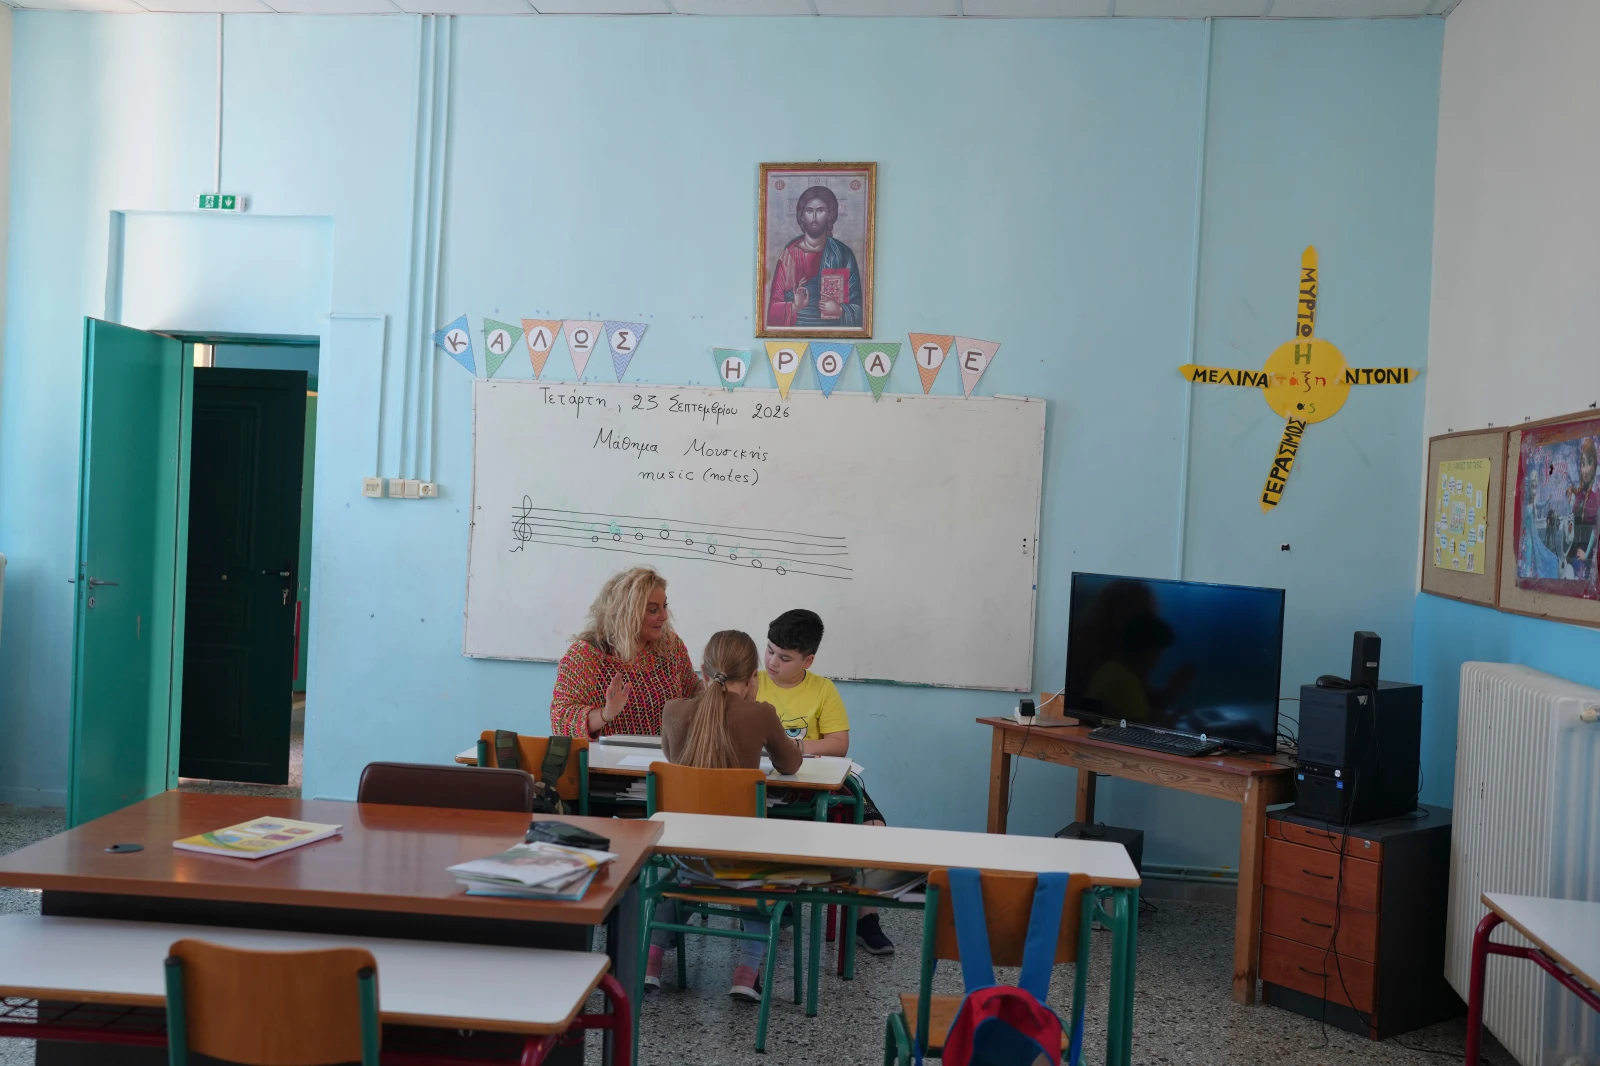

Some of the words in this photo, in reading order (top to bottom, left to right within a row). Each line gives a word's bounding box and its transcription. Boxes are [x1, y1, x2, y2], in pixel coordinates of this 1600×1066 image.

[1296, 268, 1317, 337] ΜΥΡΤΩ
[447, 330, 630, 352] ΚΑΛΩΣ
[725, 346, 983, 379] ΗΡΘΑΤΕ
[1294, 343, 1313, 365] Η
[1192, 368, 1269, 388] ΜΕΛΙΝΑ
[1275, 371, 1327, 393] τάξη
[1345, 368, 1409, 385] ΝΤΟΝΙ
[632, 394, 658, 410] 23
[669, 394, 738, 425] Σεπτεμβρίου
[752, 403, 790, 418] 2026
[593, 428, 659, 459] Μάθημα
[684, 439, 768, 461] Μουσικής
[1262, 416, 1307, 506] ΓΕΡΑΣΙΜΟΣ
[638, 470, 694, 481] music
[703, 468, 759, 486] (notes)
